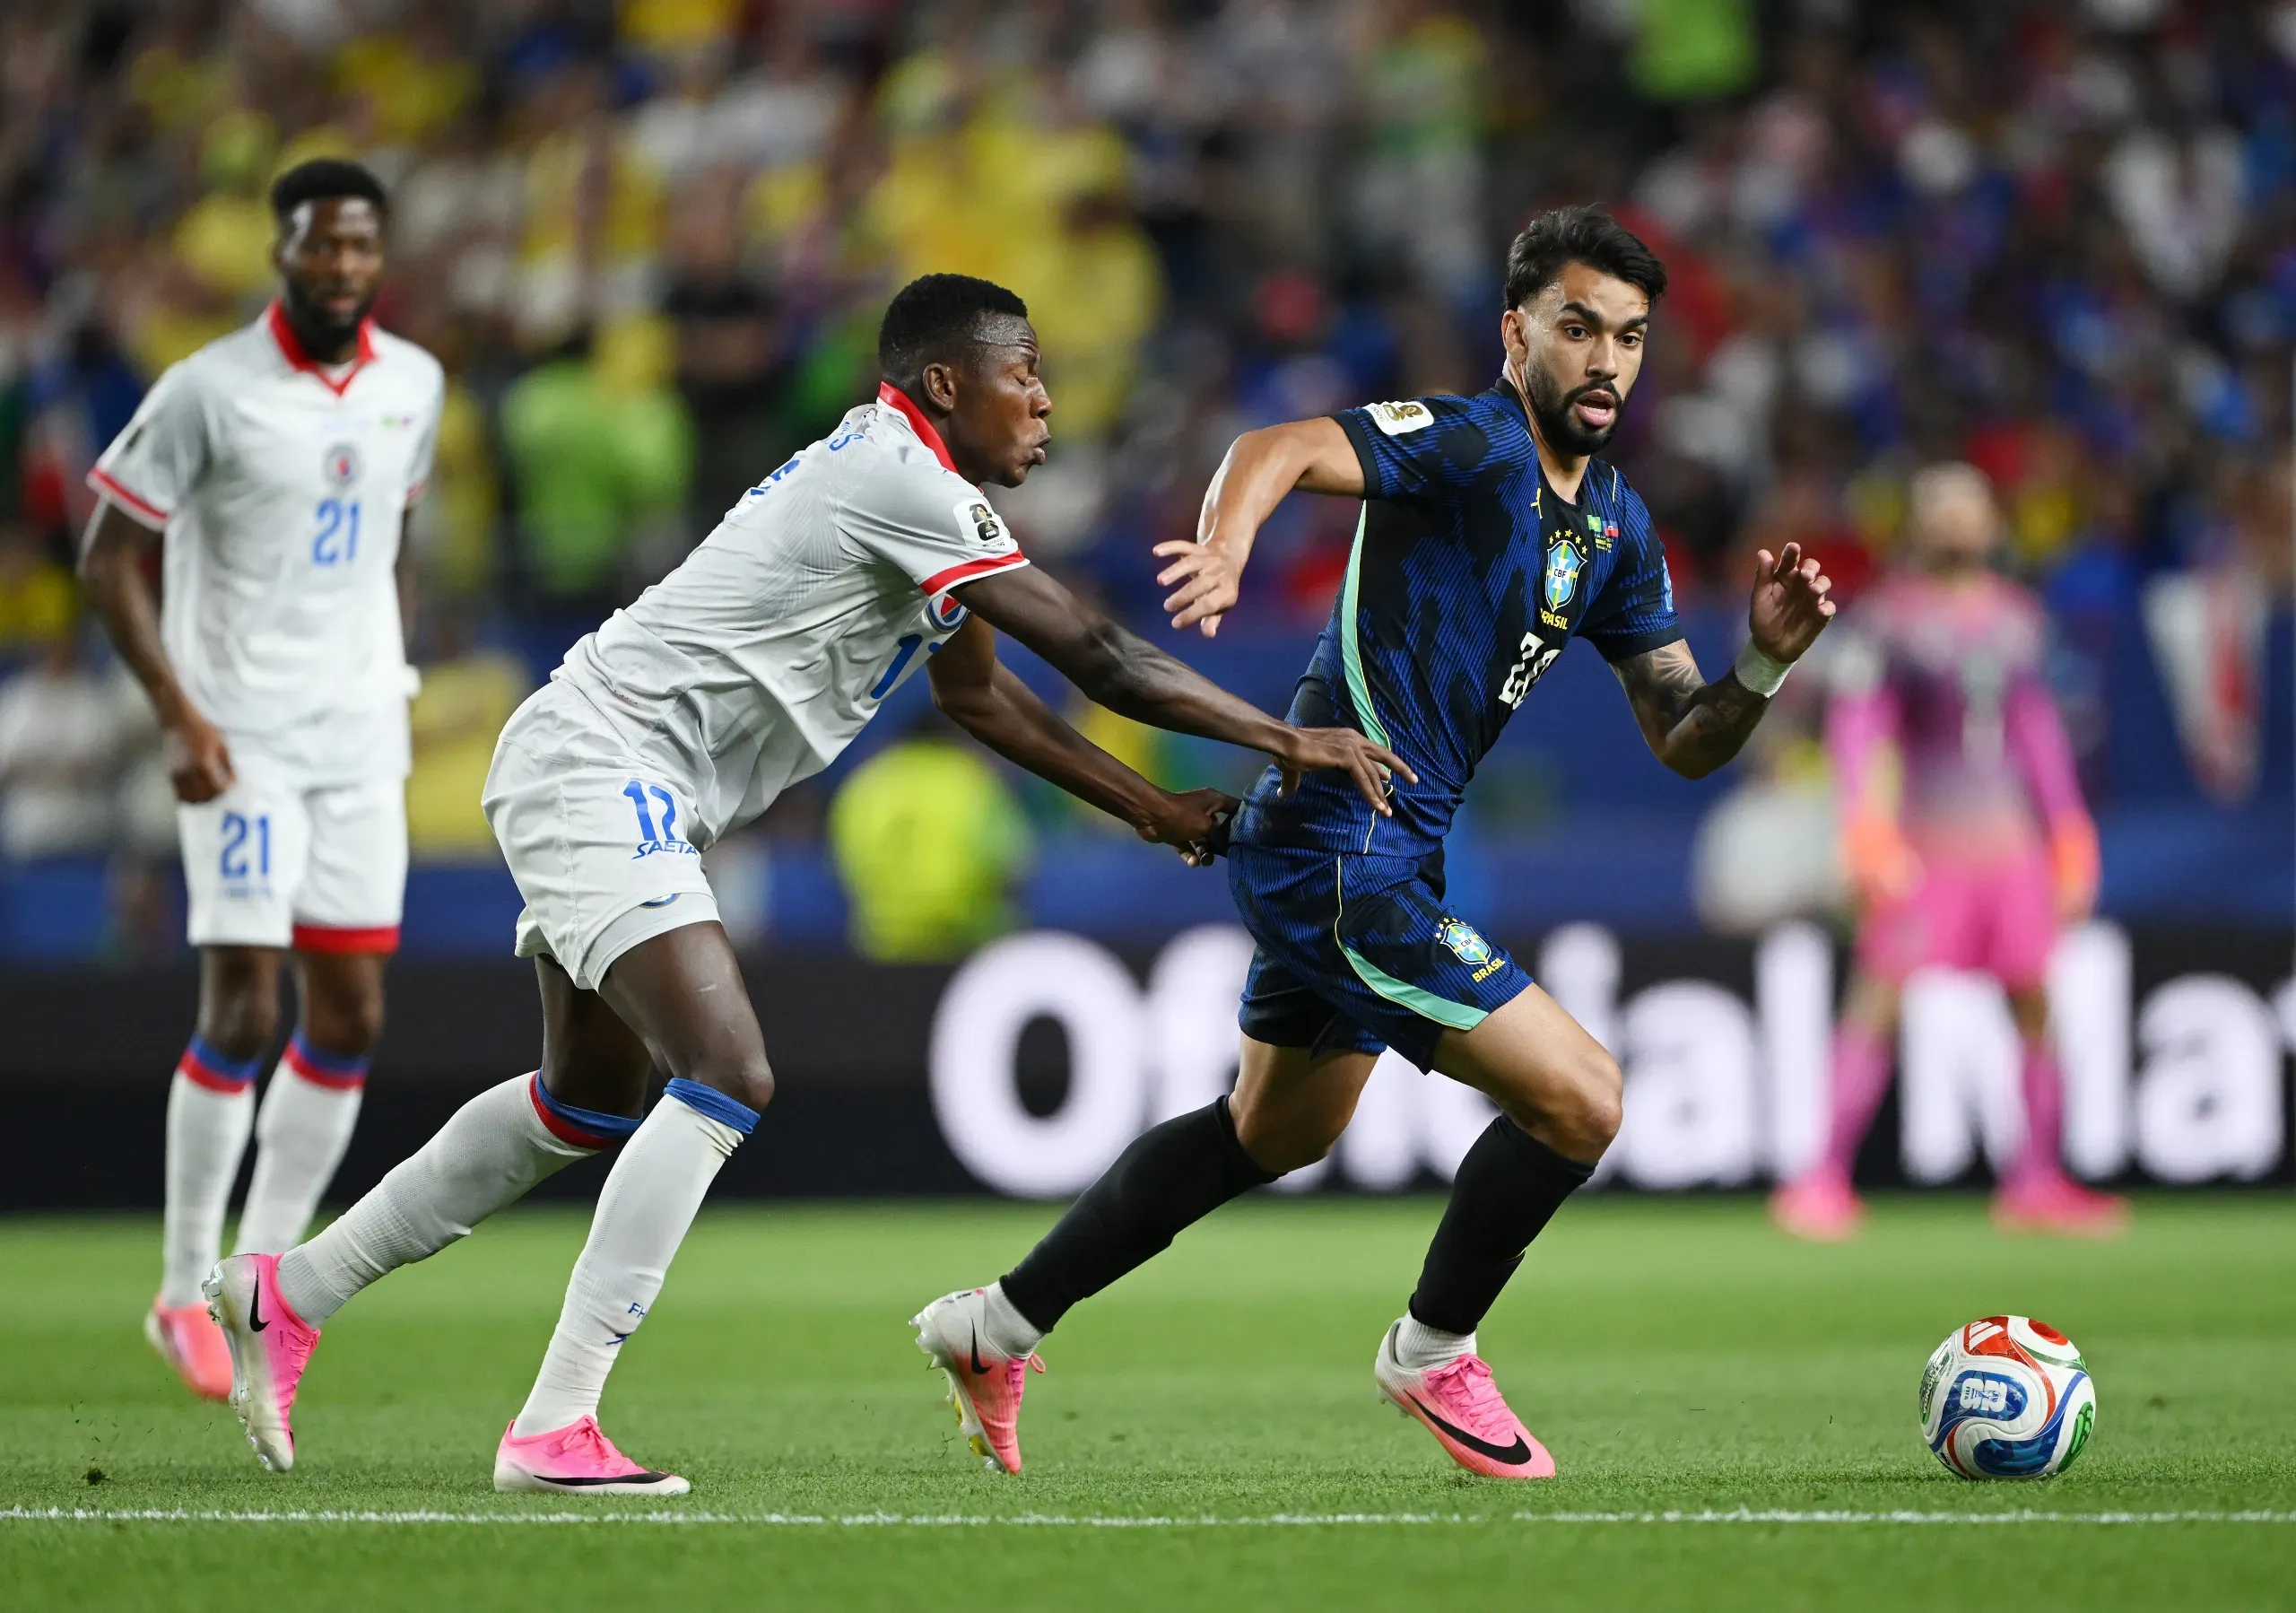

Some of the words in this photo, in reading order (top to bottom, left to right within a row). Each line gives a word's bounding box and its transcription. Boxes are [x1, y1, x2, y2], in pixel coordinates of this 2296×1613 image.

[314, 499, 360, 565] 21
[1553, 569, 1568, 579] CBF
[221, 812, 268, 879] 21
[631, 840, 698, 860] SAETA
[1460, 937, 1474, 948] CBF
[1471, 957, 1506, 983] BRASIL
